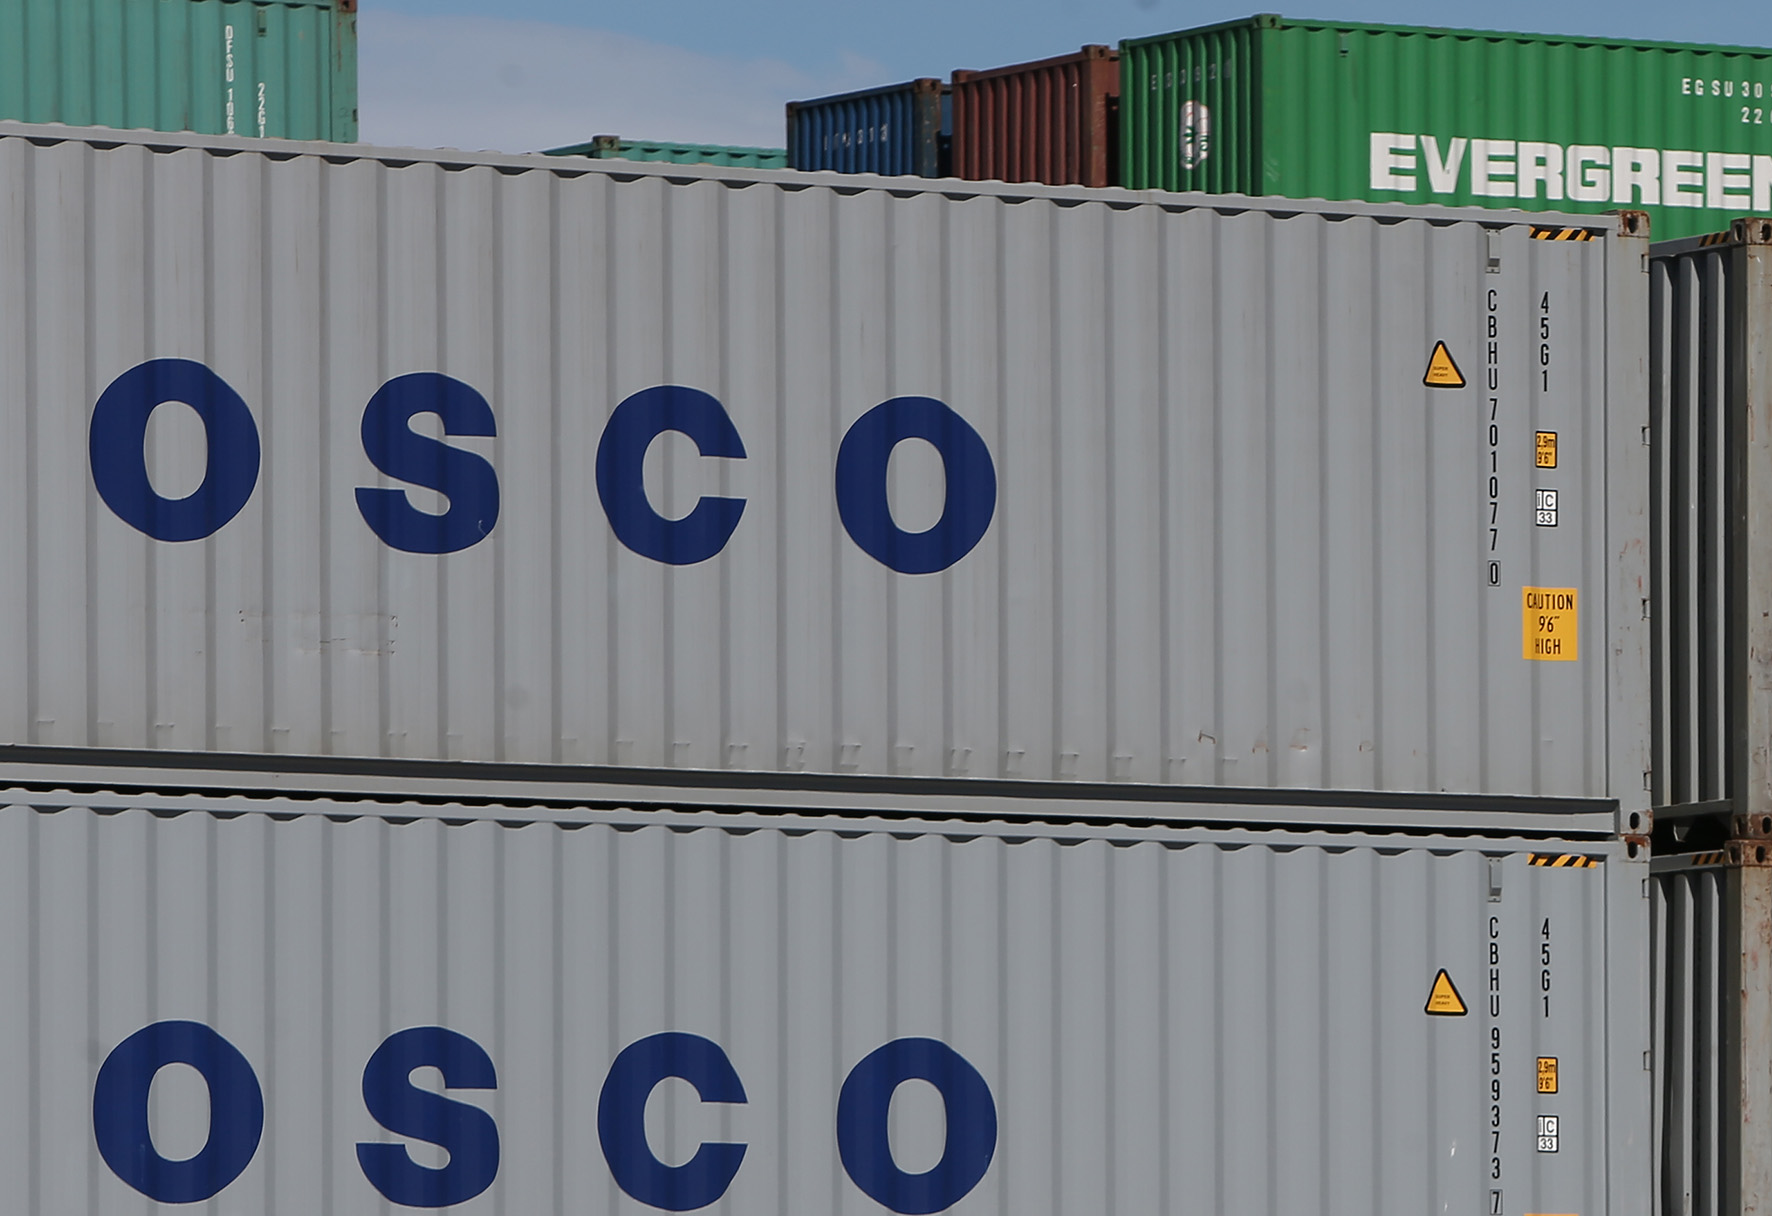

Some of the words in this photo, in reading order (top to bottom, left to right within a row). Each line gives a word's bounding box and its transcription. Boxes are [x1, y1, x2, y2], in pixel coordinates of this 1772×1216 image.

[1682, 78, 1734, 97] EGSU
[1487, 289, 1498, 391] CBHU
[1540, 291, 1550, 393] 45G1
[91, 359, 997, 574] OSCO
[1489, 397, 1498, 551] 701077
[1539, 511, 1553, 523] 33
[1489, 562, 1499, 585] 0
[1527, 592, 1574, 611] CAUTION
[1535, 638, 1561, 655] HIGH
[1489, 916, 1500, 1018] CBHU
[1541, 917, 1551, 1018] 45G1
[94, 1021, 997, 1214] OSCO
[1491, 1026, 1501, 1180] 959373
[1540, 1138, 1553, 1149] 33
[1491, 1190, 1500, 1214] 7
